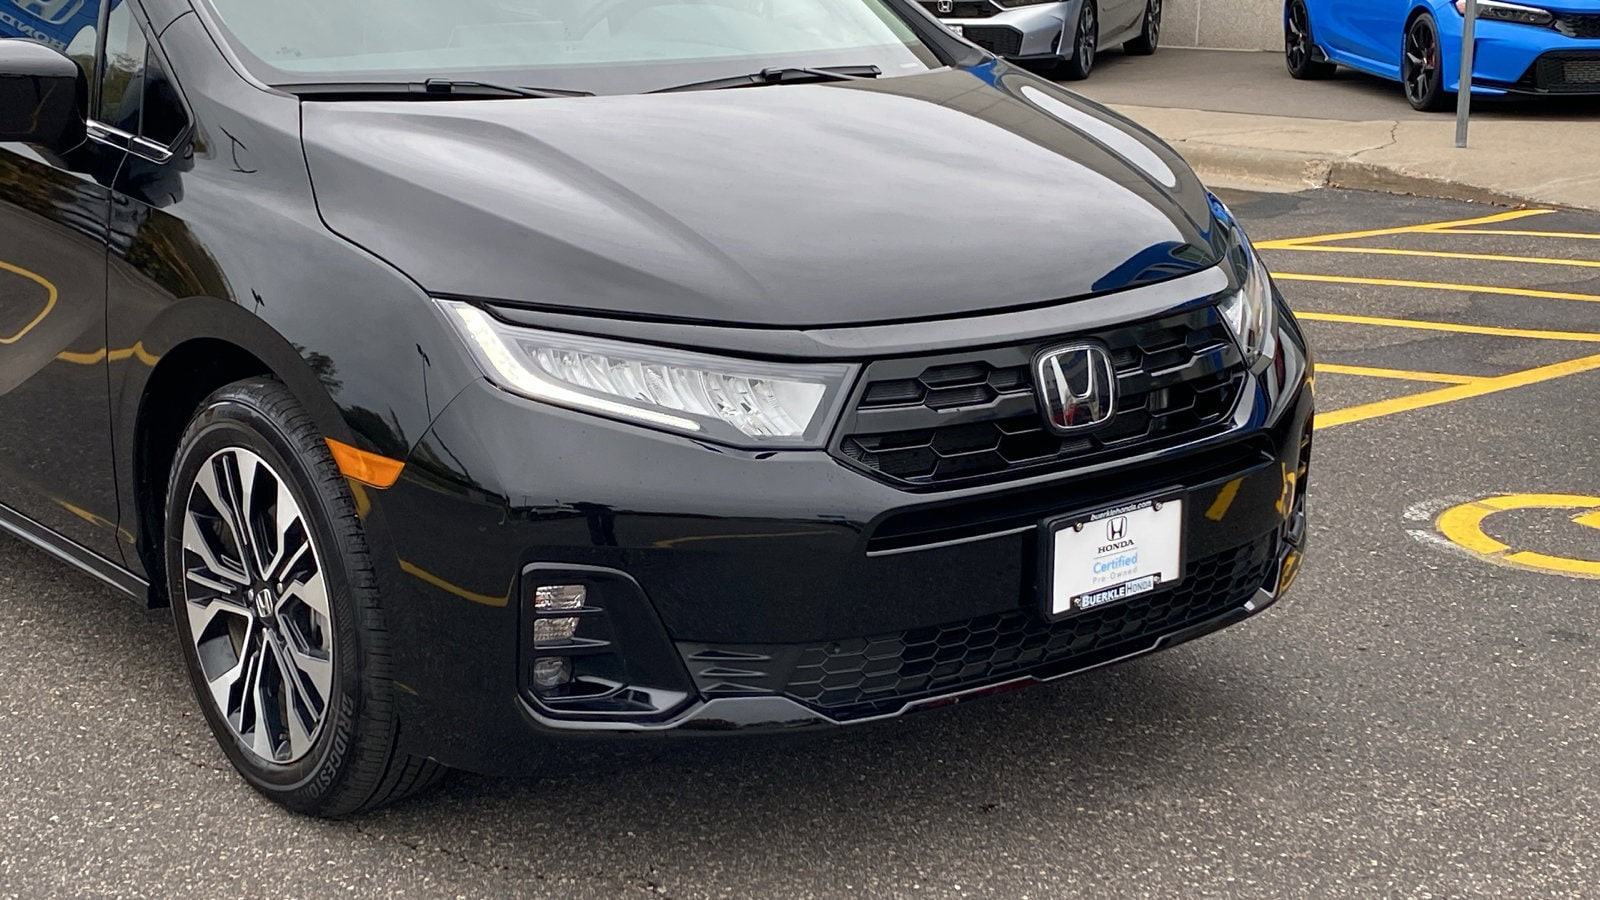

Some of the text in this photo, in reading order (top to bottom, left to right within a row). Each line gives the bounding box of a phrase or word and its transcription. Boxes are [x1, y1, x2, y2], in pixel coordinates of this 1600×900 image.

[1090, 500, 1152, 521] buerklehonda.com
[1097, 539, 1135, 554] HONDA
[1093, 552, 1138, 574] Certified
[1081, 580, 1152, 607] BUERKLE HONDA
[302, 691, 354, 800] BRIDGESTO
